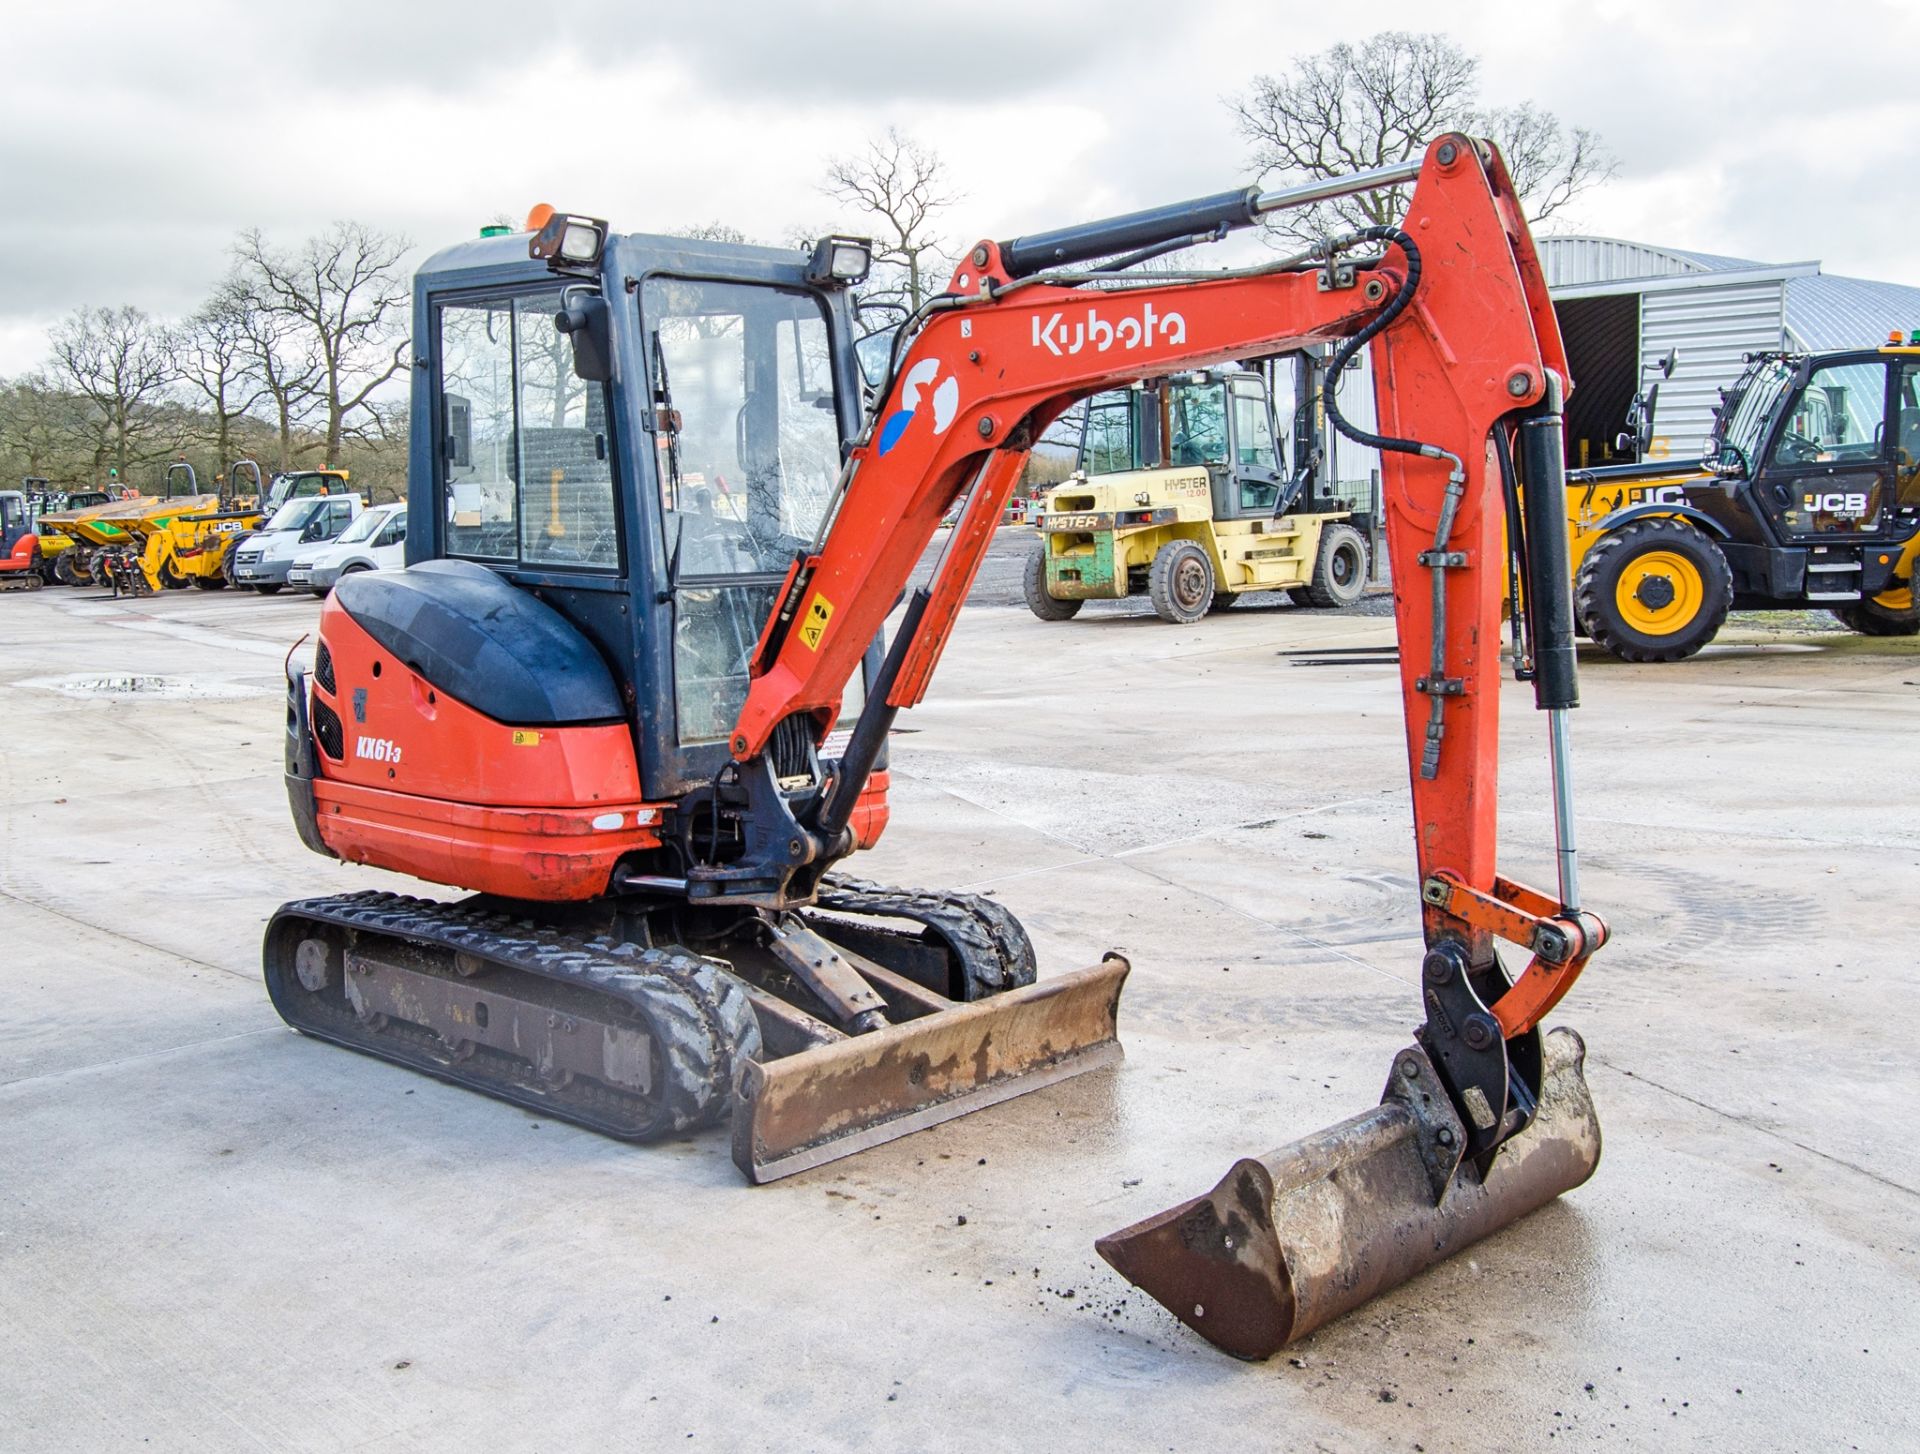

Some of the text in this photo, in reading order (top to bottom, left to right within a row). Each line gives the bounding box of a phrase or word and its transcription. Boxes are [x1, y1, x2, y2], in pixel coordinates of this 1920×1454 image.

[1032, 303, 1186, 356] Kubota
[1164, 477, 1207, 491] HYSTER
[1804, 493, 1867, 511] JCB
[213, 521, 243, 532] JCB
[1047, 515, 1099, 529] HYSTER
[356, 736, 402, 764] KX61-3
